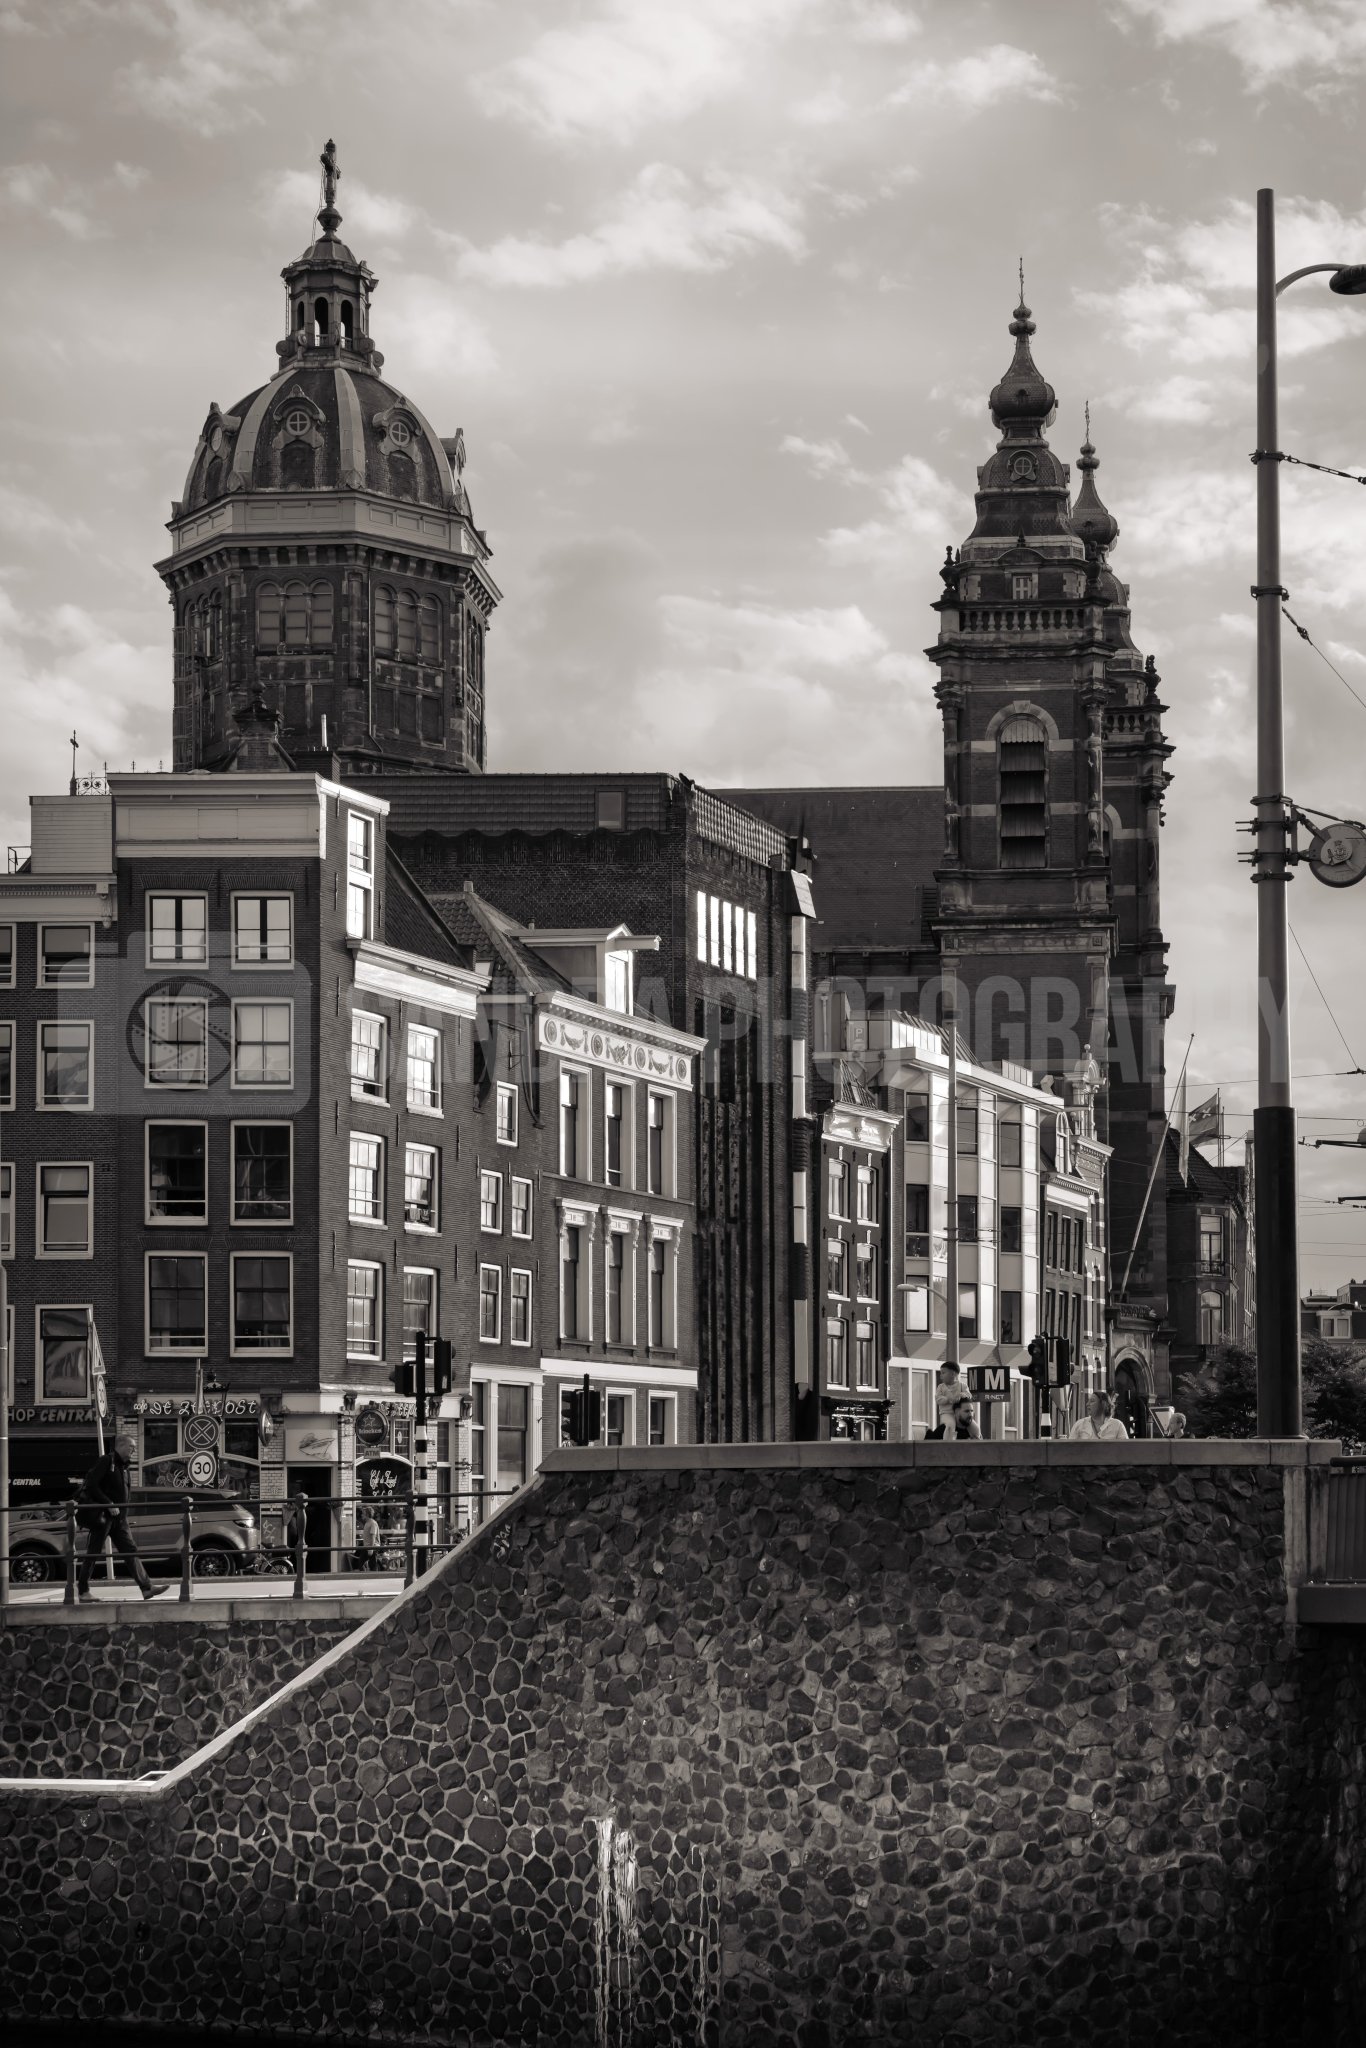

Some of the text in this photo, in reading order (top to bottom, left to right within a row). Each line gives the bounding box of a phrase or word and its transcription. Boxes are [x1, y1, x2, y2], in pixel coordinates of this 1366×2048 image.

[985, 1369, 1004, 1390] M
[194, 1461, 211, 1475] 30
[12, 1478, 41, 1486] CENTRAL
